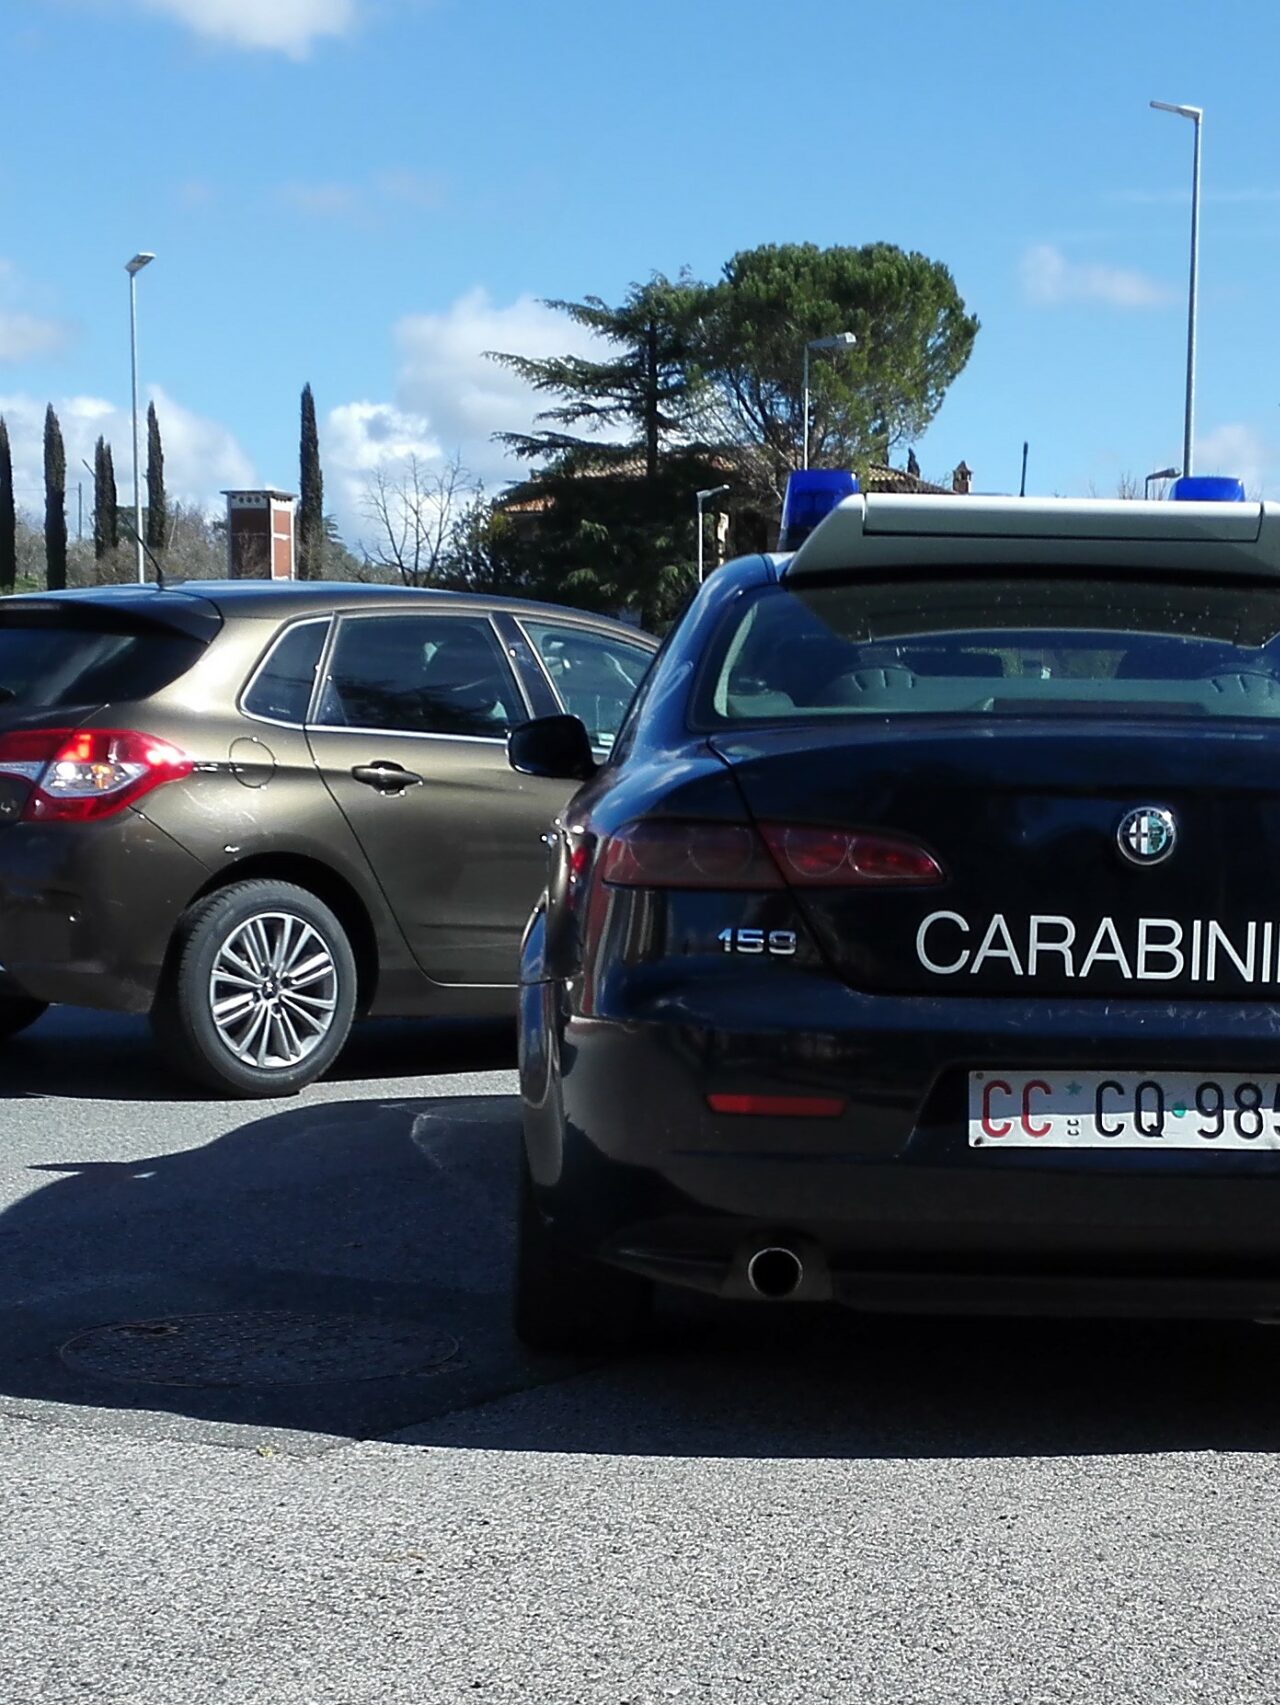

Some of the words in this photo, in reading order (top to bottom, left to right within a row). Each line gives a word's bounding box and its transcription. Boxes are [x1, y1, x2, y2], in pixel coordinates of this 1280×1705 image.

[717, 927, 797, 955] 159
[981, 1079, 1052, 1138] CC
[1094, 1080, 1165, 1139] CQ
